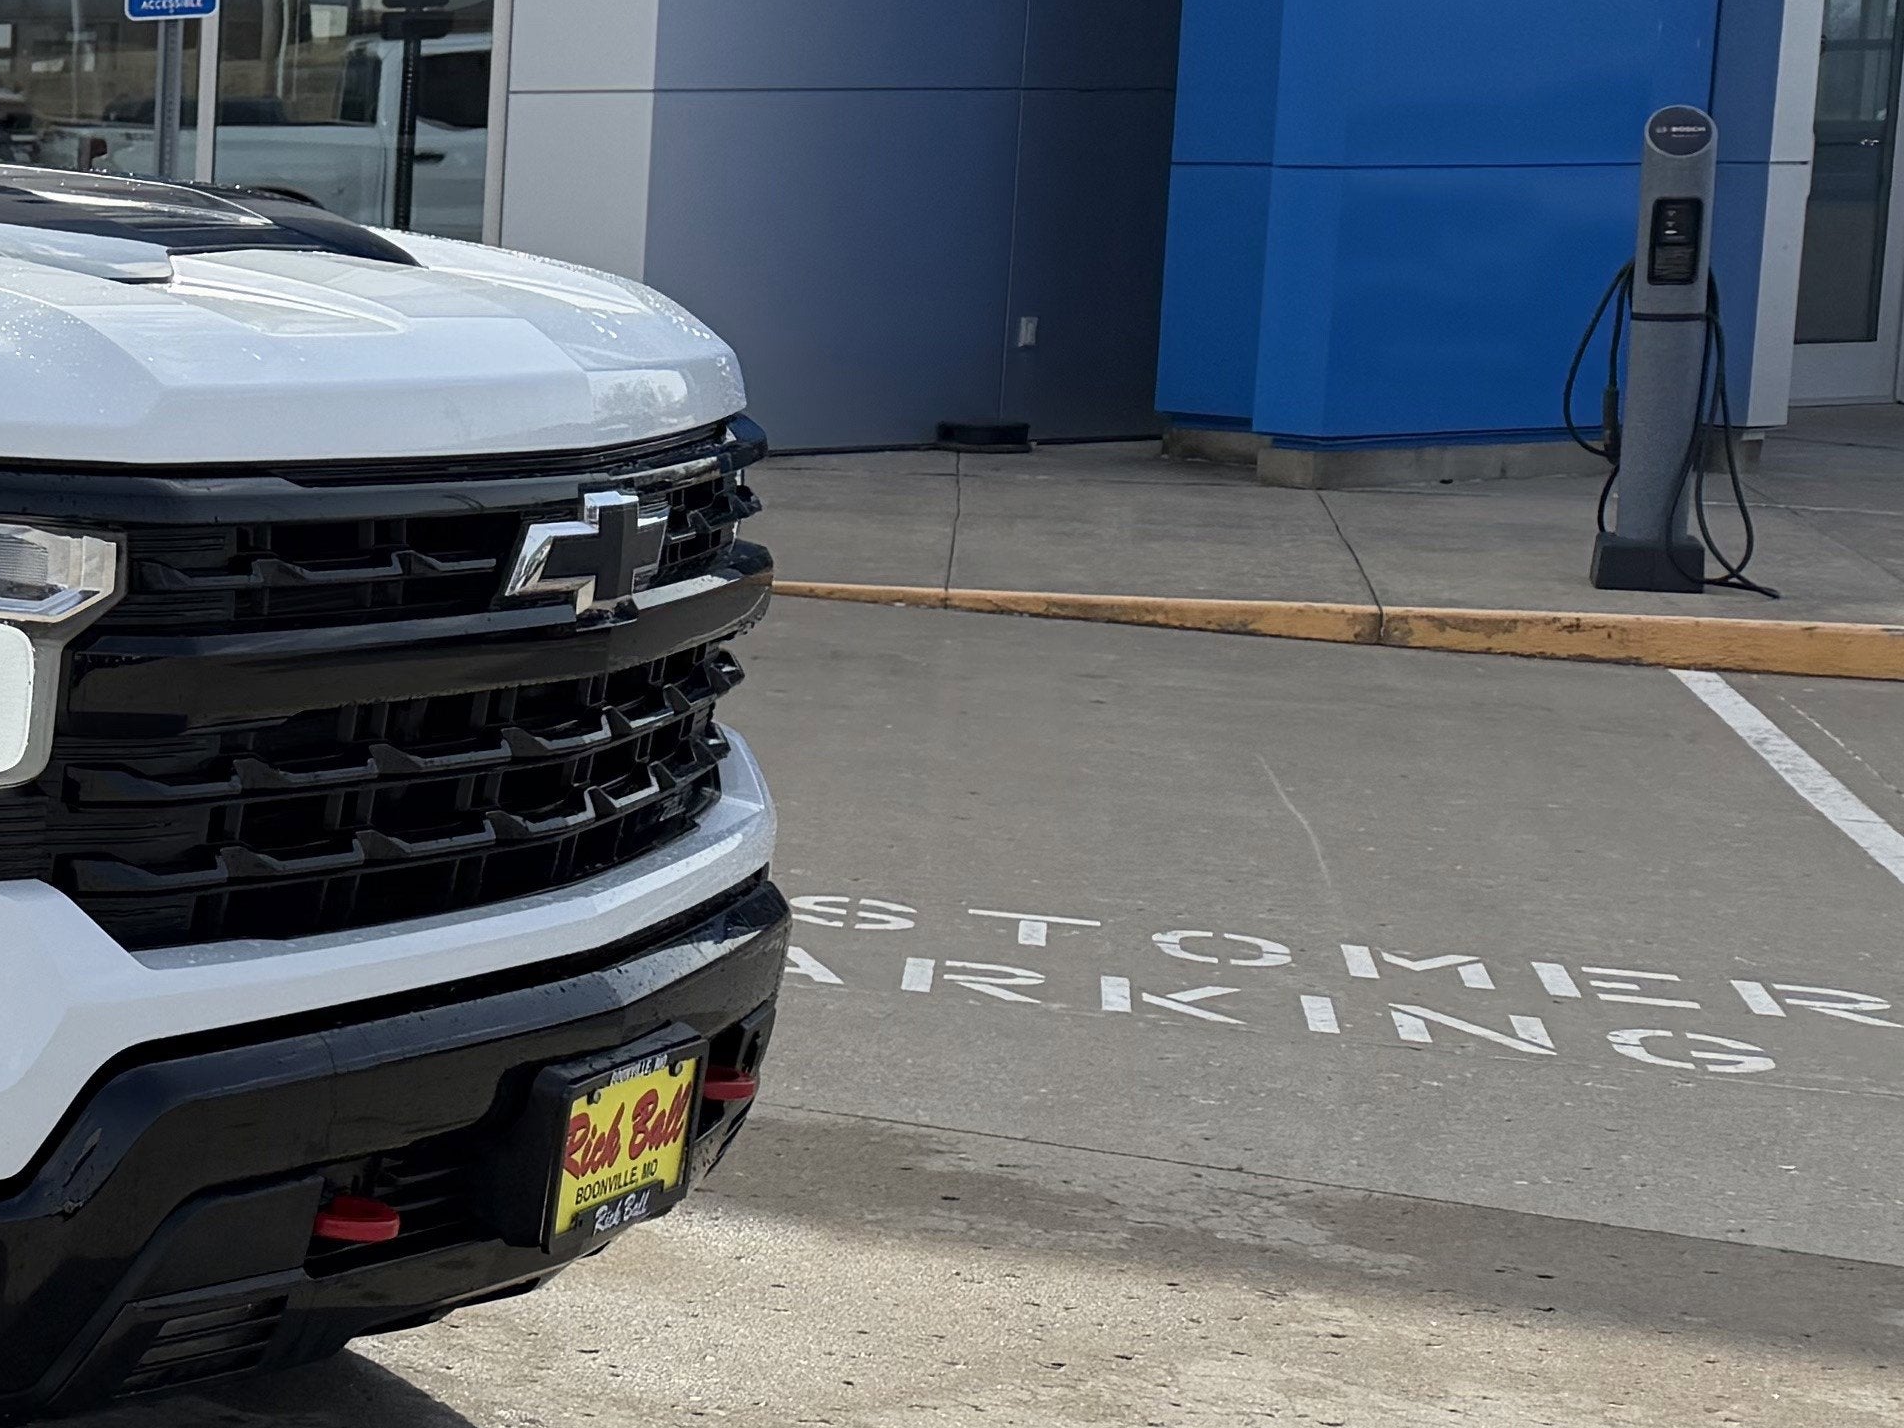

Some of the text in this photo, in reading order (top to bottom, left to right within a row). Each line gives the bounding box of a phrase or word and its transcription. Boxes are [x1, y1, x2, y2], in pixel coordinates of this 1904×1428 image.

[563, 1080, 692, 1180] Rick Ball
[641, 1158, 658, 1181] MO
[592, 1189, 652, 1237] Rick Ball
